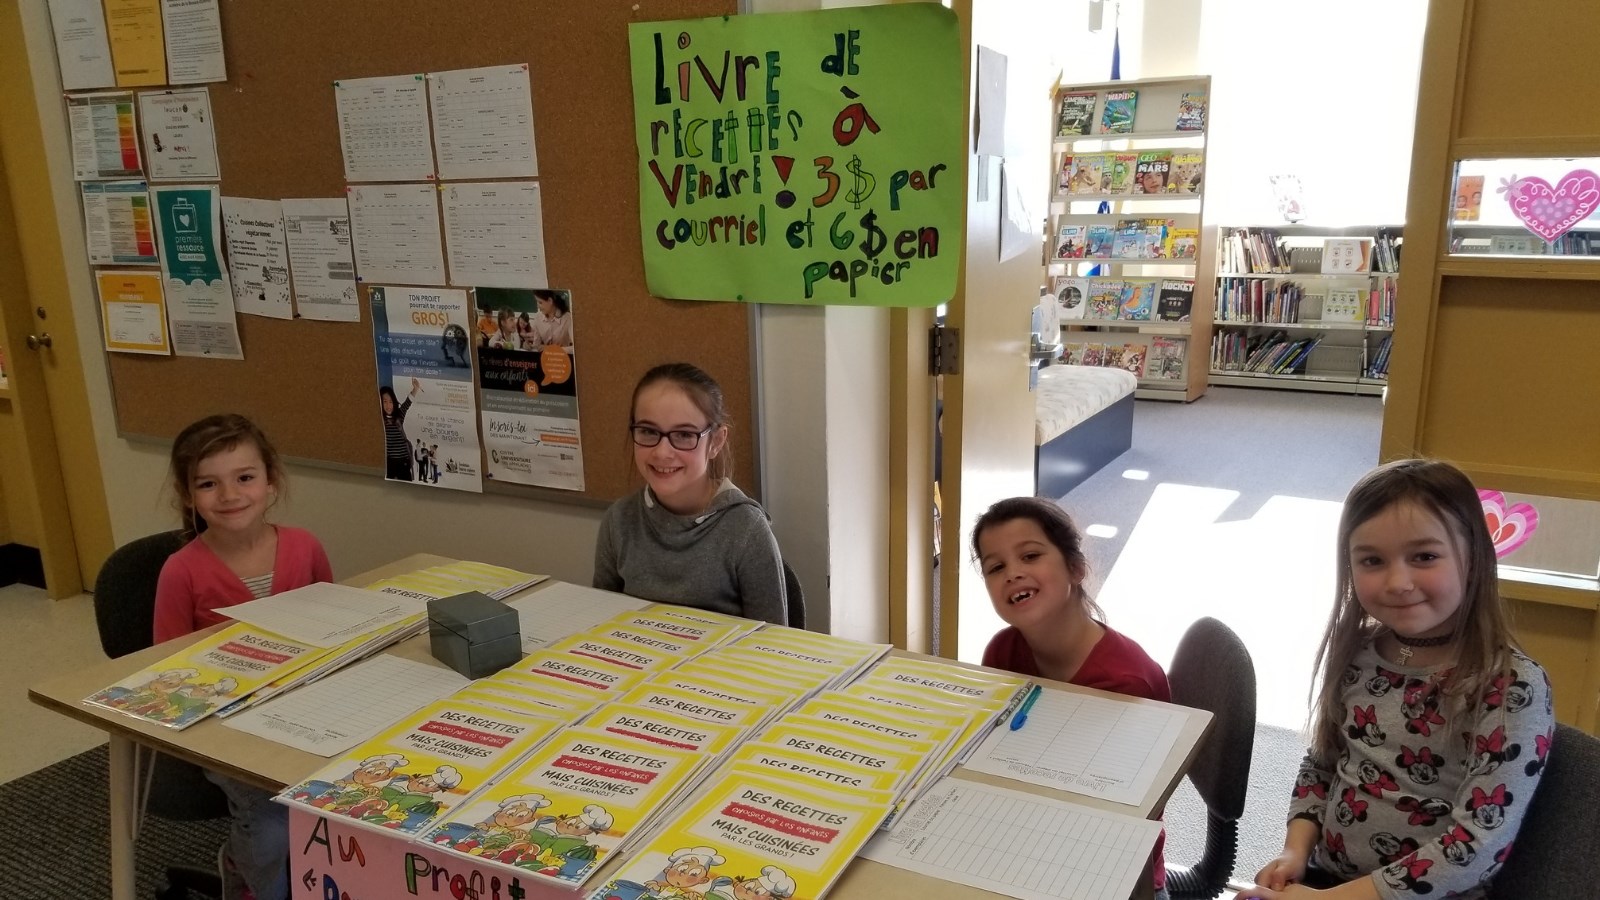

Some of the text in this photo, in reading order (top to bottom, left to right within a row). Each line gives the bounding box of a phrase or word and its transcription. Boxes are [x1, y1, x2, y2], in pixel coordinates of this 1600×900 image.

[1138, 164, 1168, 172] MARS
[890, 163, 946, 211] par
[656, 204, 766, 250] courriel
[786, 208, 814, 249] et
[894, 226, 940, 259] en
[803, 259, 910, 299] papier
[1162, 280, 1194, 292] HOCKEY
[528, 384, 536, 392] ici
[634, 618, 654, 628] DES
[654, 622, 706, 636] RECETTES
[610, 630, 682, 651] DES RECETTES
[579, 642, 652, 665] DES RECETTES
[542, 660, 619, 684] DES RECETTES
[894, 674, 984, 696] DES RECETTES
[648, 696, 736, 720] DES RECETTES
[440, 712, 525, 734] DES RECETTES
[616, 716, 707, 742] DES RECETTES
[406, 734, 492, 758] MAIS CUISINÉES
[572, 744, 666, 769] DES RECETTES
[786, 738, 886, 768] DES RECETTES
[542, 770, 638, 796] MAIS CUISINÉES
[742, 790, 847, 824] DES RECETTES
[304, 817, 366, 866] Au
[712, 819, 820, 856] MAIS CUISINÉES
[720, 832, 738, 841] PAR
[740, 838, 753, 846] LES
